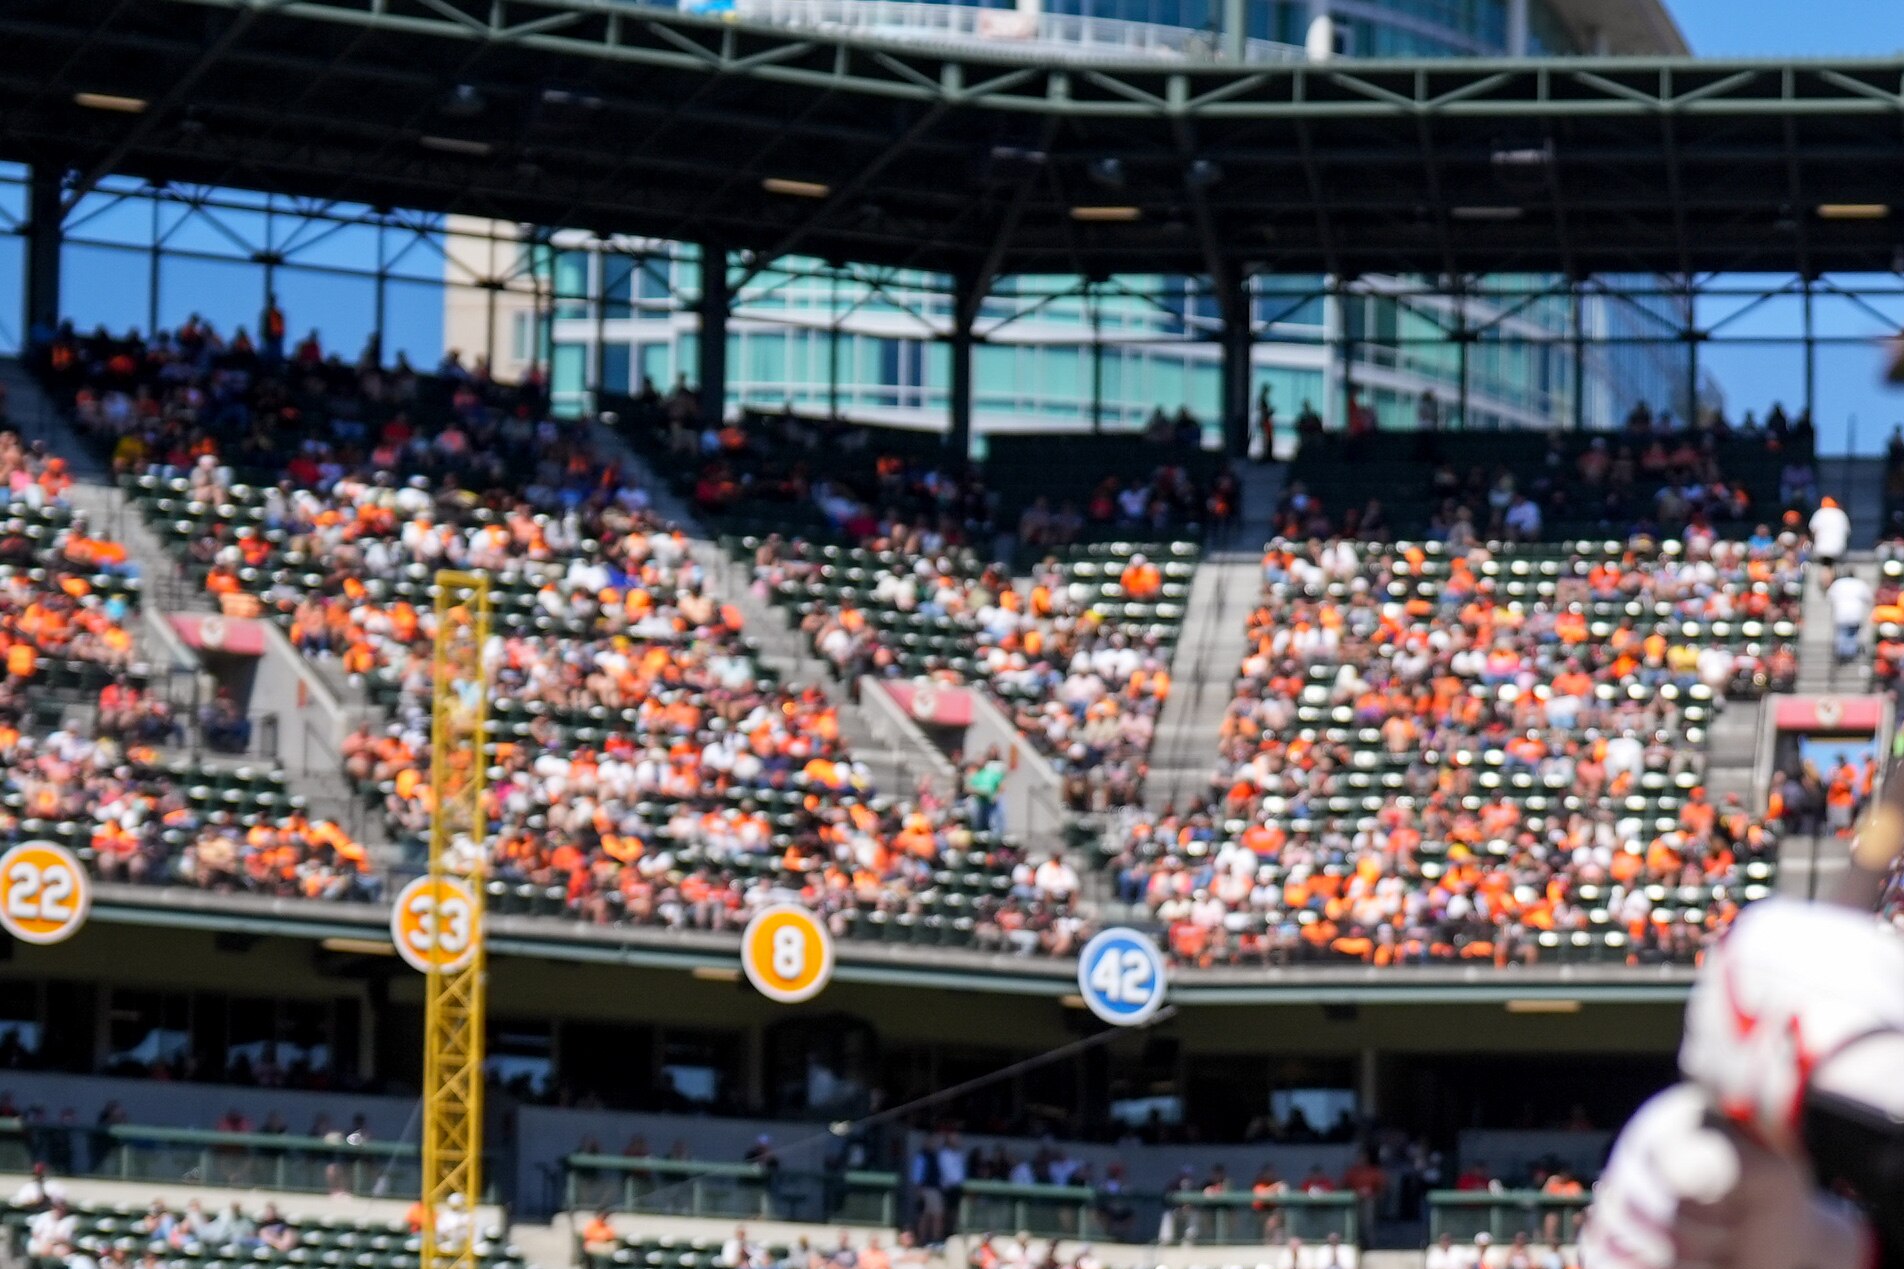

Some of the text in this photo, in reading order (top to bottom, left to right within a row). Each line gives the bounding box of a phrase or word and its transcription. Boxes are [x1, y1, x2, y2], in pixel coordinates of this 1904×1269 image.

[8, 861, 73, 921] 22
[408, 894, 471, 953] 33
[772, 924, 805, 981] 8
[1091, 947, 1154, 1005] 42
